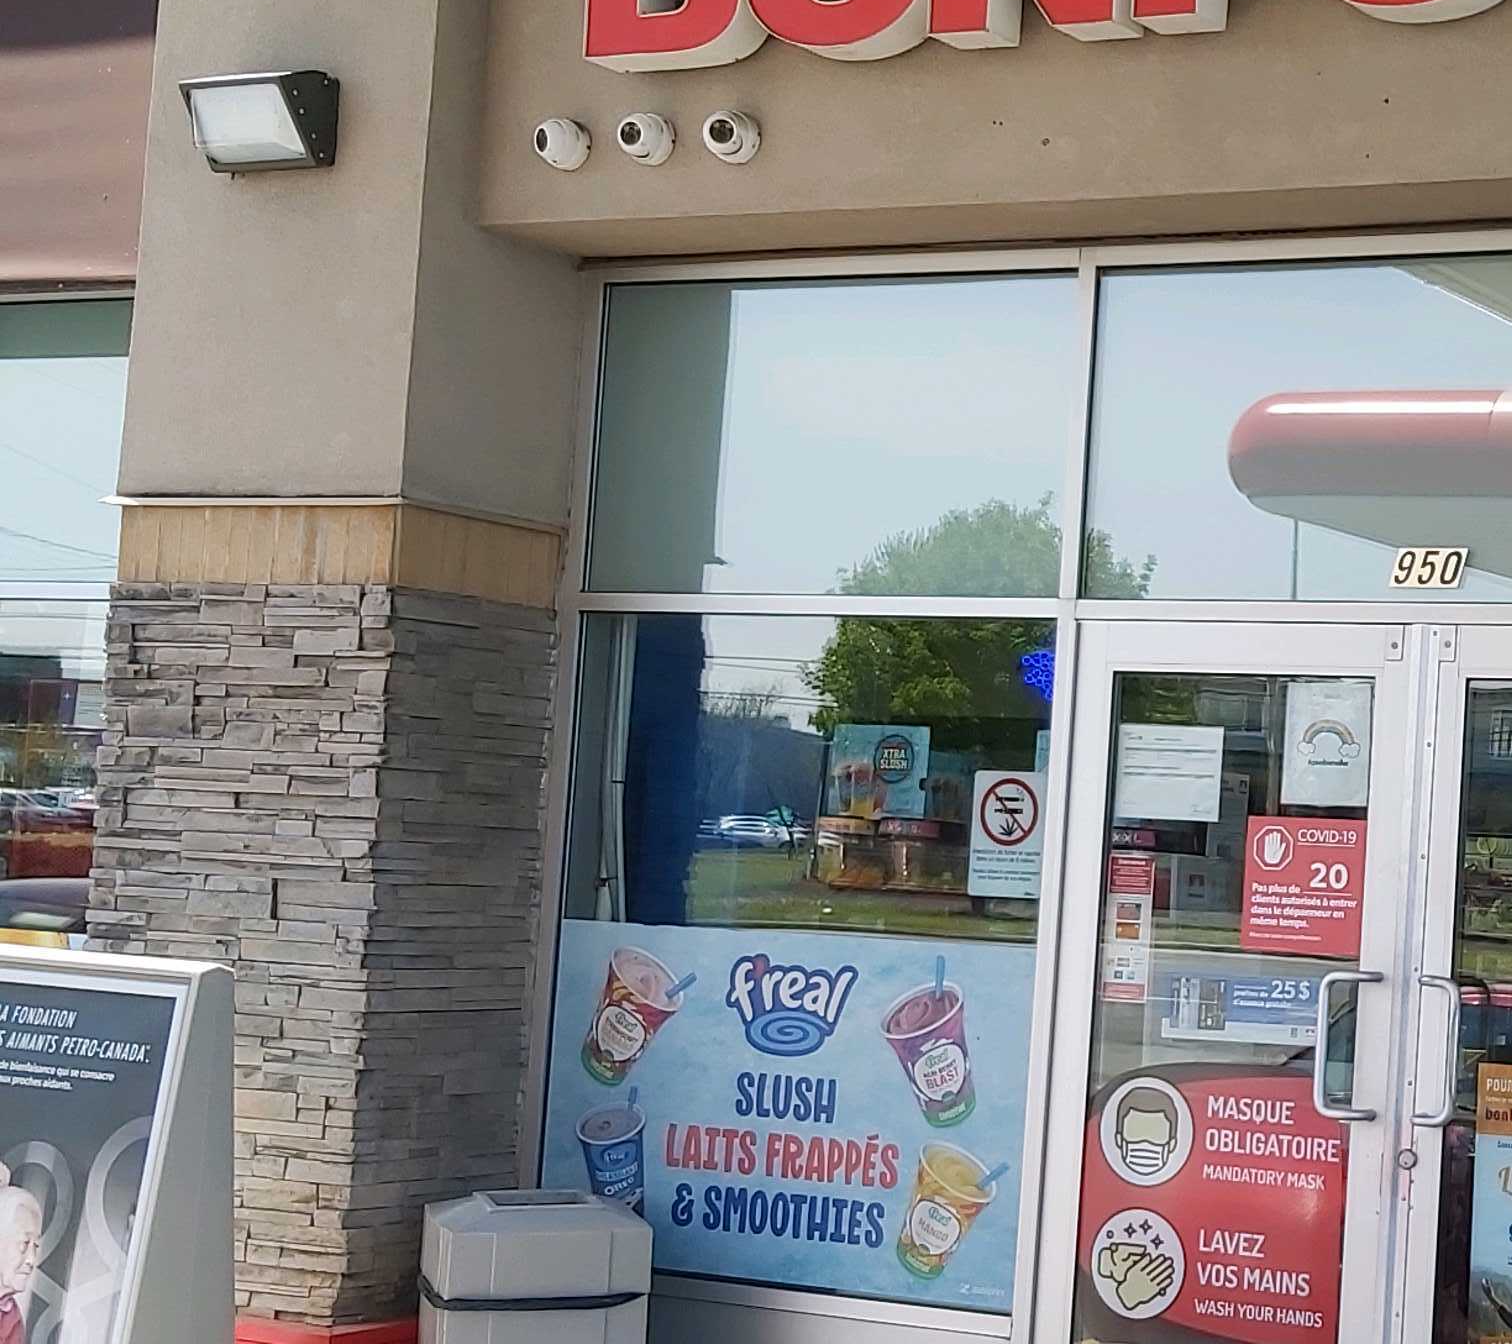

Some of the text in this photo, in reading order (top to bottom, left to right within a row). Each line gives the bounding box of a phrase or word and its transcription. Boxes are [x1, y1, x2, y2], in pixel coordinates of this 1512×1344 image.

[1394, 550, 1463, 585] 950
[883, 748, 905, 759] XTRA
[1298, 829, 1357, 844] COVID-19
[1268, 884, 1287, 894] plus
[1288, 885, 1301, 894] de
[1309, 863, 1348, 889] 20
[1251, 894, 1280, 904] clients
[1329, 899, 1357, 908] entrer
[1251, 905, 1272, 915] dans
[1274, 906, 1282, 915] le
[1333, 910, 1345, 919] en
[1271, 980, 1296, 999] 25
[1299, 981, 1310, 1000] $
[12, 1006, 77, 1028] FONDATION
[6, 1031, 59, 1053] AIMANTS
[926, 1067, 959, 1089] BLAST
[735, 1071, 838, 1124] SLUSH
[1207, 1095, 1295, 1125] MASQUE
[665, 1123, 757, 1175] LAITS
[765, 1133, 900, 1189] FRAPPÉS
[1205, 1128, 1341, 1162] OBLIGATOIRE
[1202, 1164, 1325, 1191] MANDATORY MASK
[671, 1182, 885, 1248] & SMOOTHIES
[1199, 1229, 1265, 1258] LAVEZ
[1197, 1262, 1310, 1296] VOS MAINS
[1194, 1298, 1323, 1328] WASH YOUR HANDS
